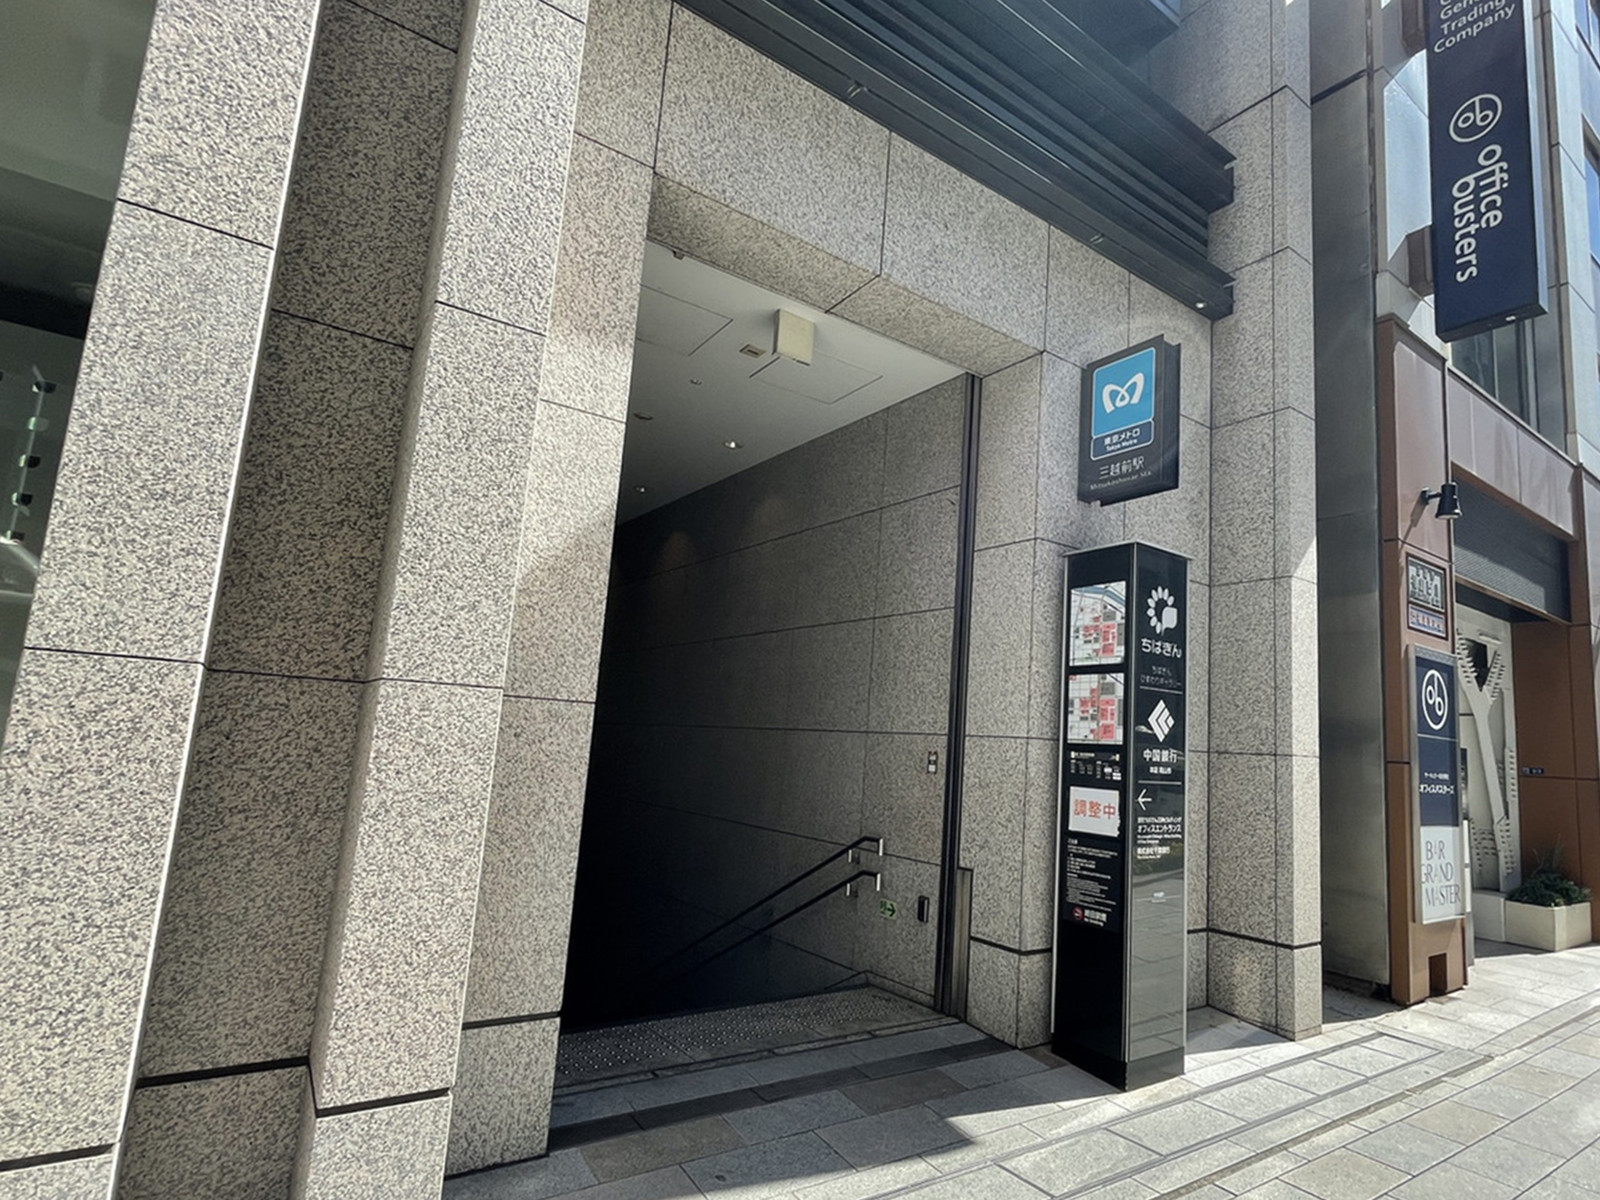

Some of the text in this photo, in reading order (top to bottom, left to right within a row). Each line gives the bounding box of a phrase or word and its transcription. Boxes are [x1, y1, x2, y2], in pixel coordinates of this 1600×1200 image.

[1433, 4, 1515, 53] Company
[1440, 0, 1506, 35] Trading
[1476, 144, 1508, 229] office
[1452, 170, 1480, 283] busters
[1104, 428, 1140, 445] 東京メトロ
[1099, 456, 1144, 479] 三越前駅
[1141, 637, 1182, 659] ちばぎん
[1143, 747, 1177, 764] 中国銀行
[1073, 798, 1117, 820] 調整中
